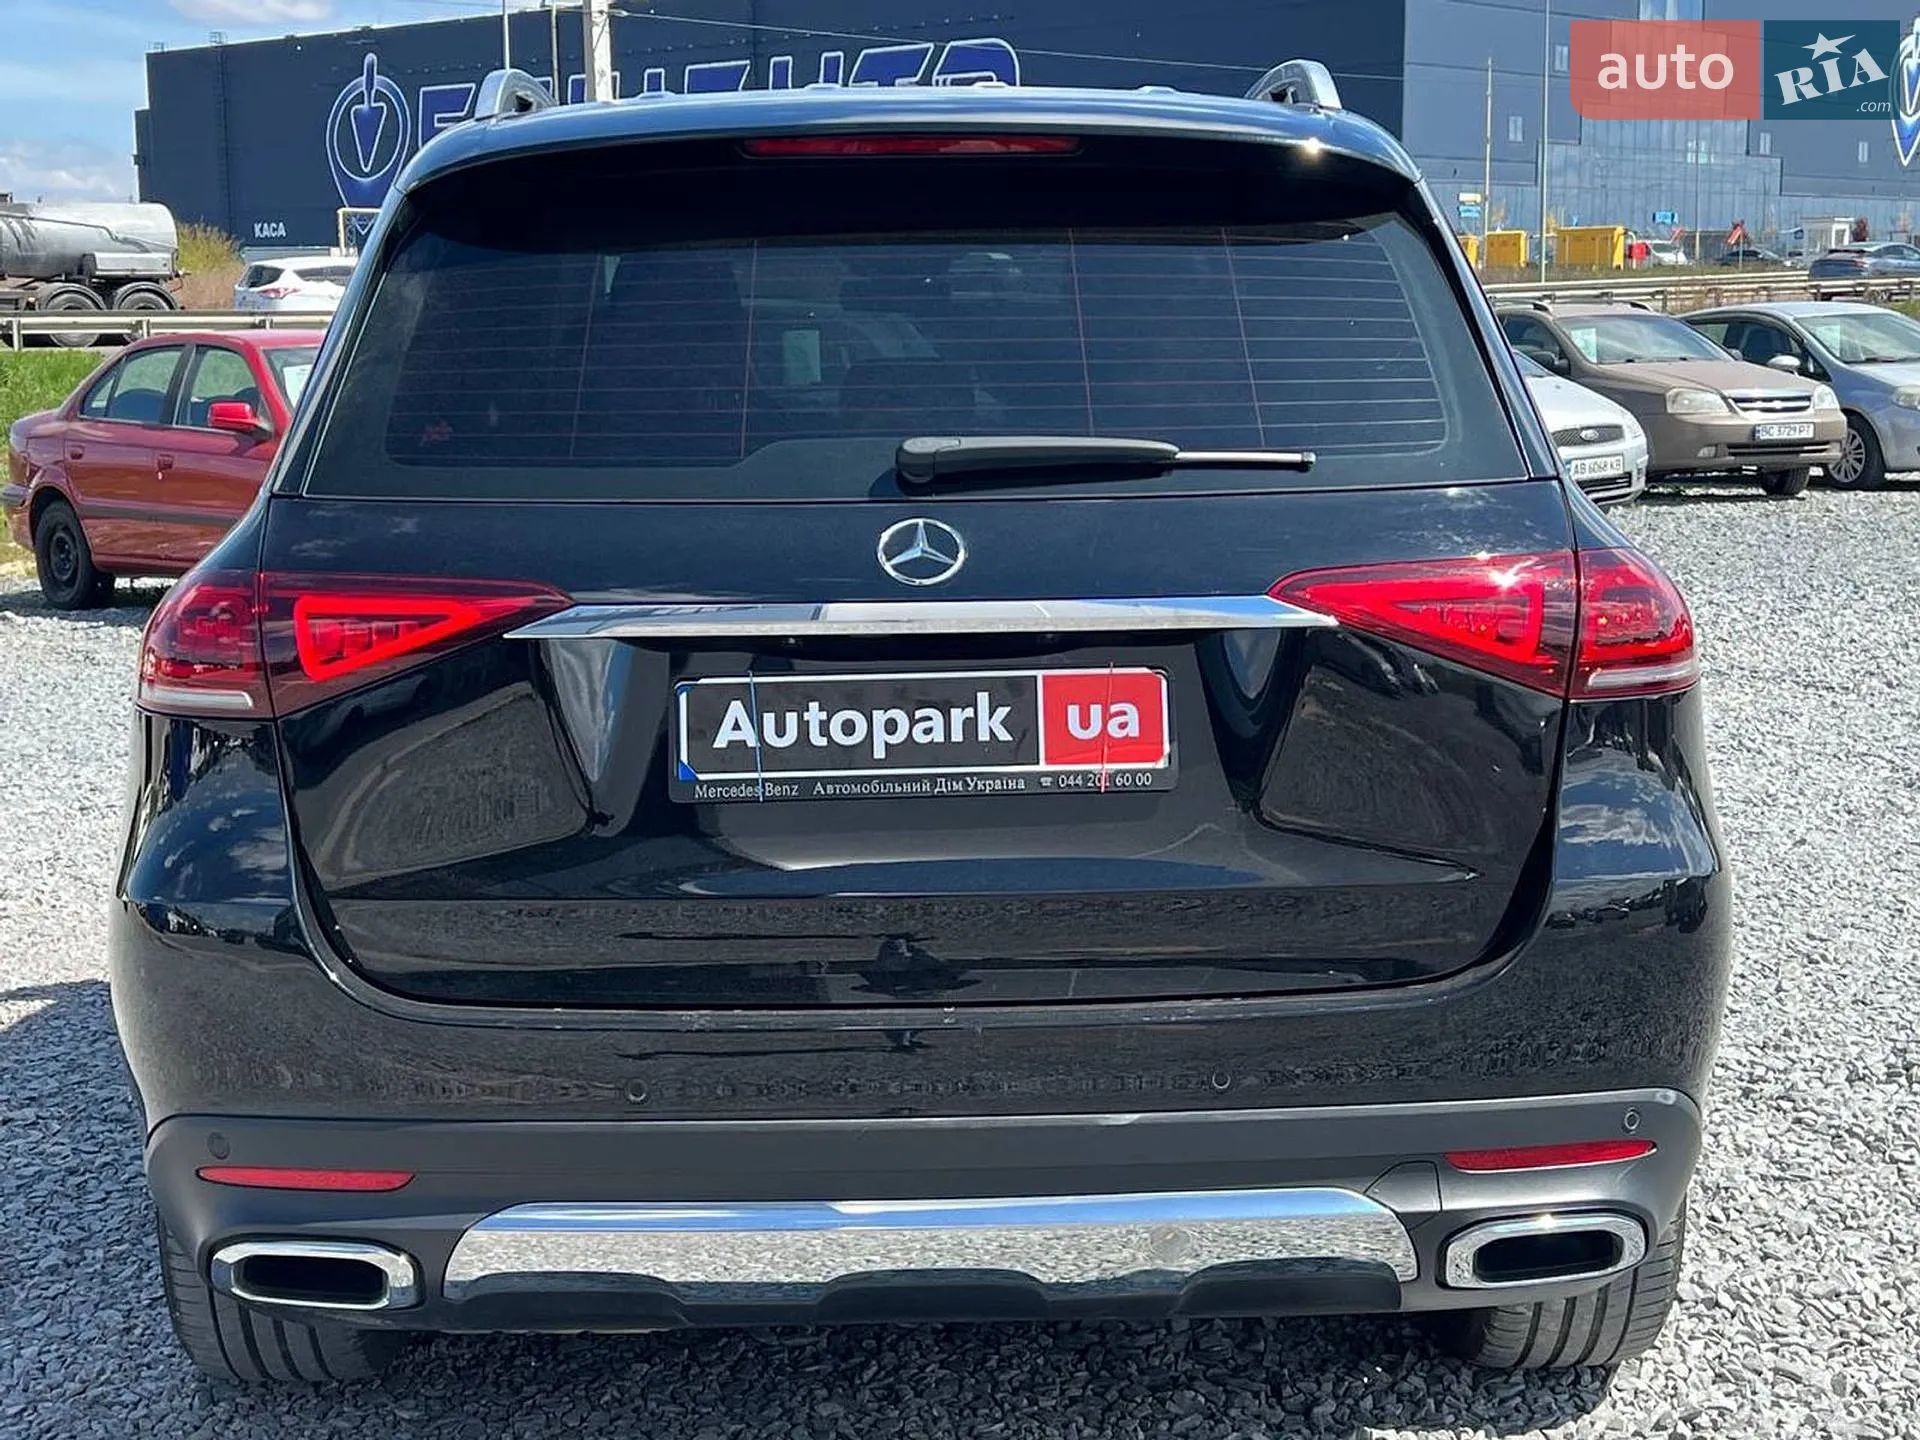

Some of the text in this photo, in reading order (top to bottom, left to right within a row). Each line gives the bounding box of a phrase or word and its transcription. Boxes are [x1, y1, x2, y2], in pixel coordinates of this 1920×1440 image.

[254, 222, 286, 238] КАСА
[712, 691, 1140, 759] Autopark ua
[813, 776, 1026, 796] Автомобільний Дім Україна
[1058, 774, 1083, 788] 044
[1115, 773, 1132, 787] 60
[1135, 772, 1152, 786] 00
